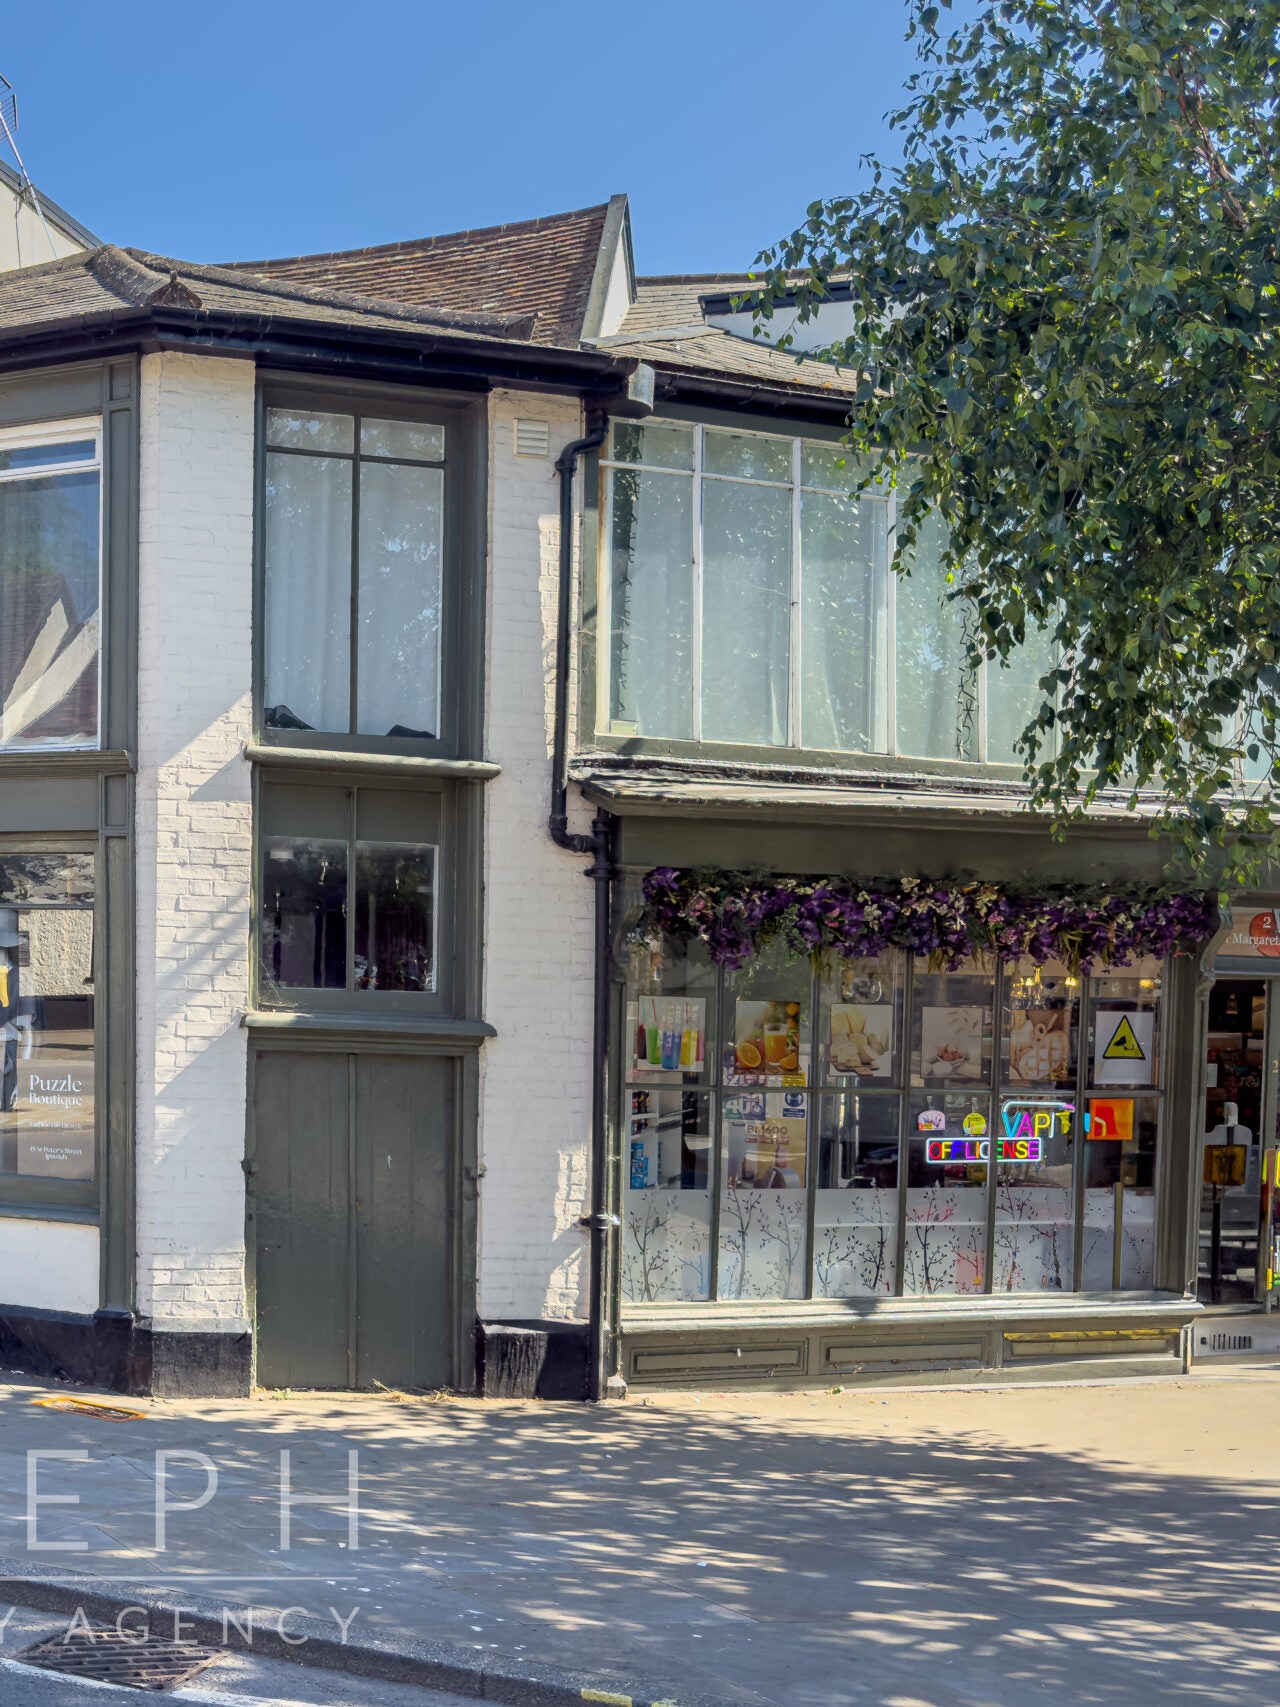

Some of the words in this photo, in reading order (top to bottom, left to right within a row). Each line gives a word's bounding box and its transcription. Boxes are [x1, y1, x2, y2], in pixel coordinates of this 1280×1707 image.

[1262, 916, 1272, 929] 2
[29, 1074, 82, 1092] Puzzle
[29, 1092, 82, 1109] Boutique
[929, 1141, 963, 1160] OFF
[965, 1141, 1039, 1160] LICENSE
